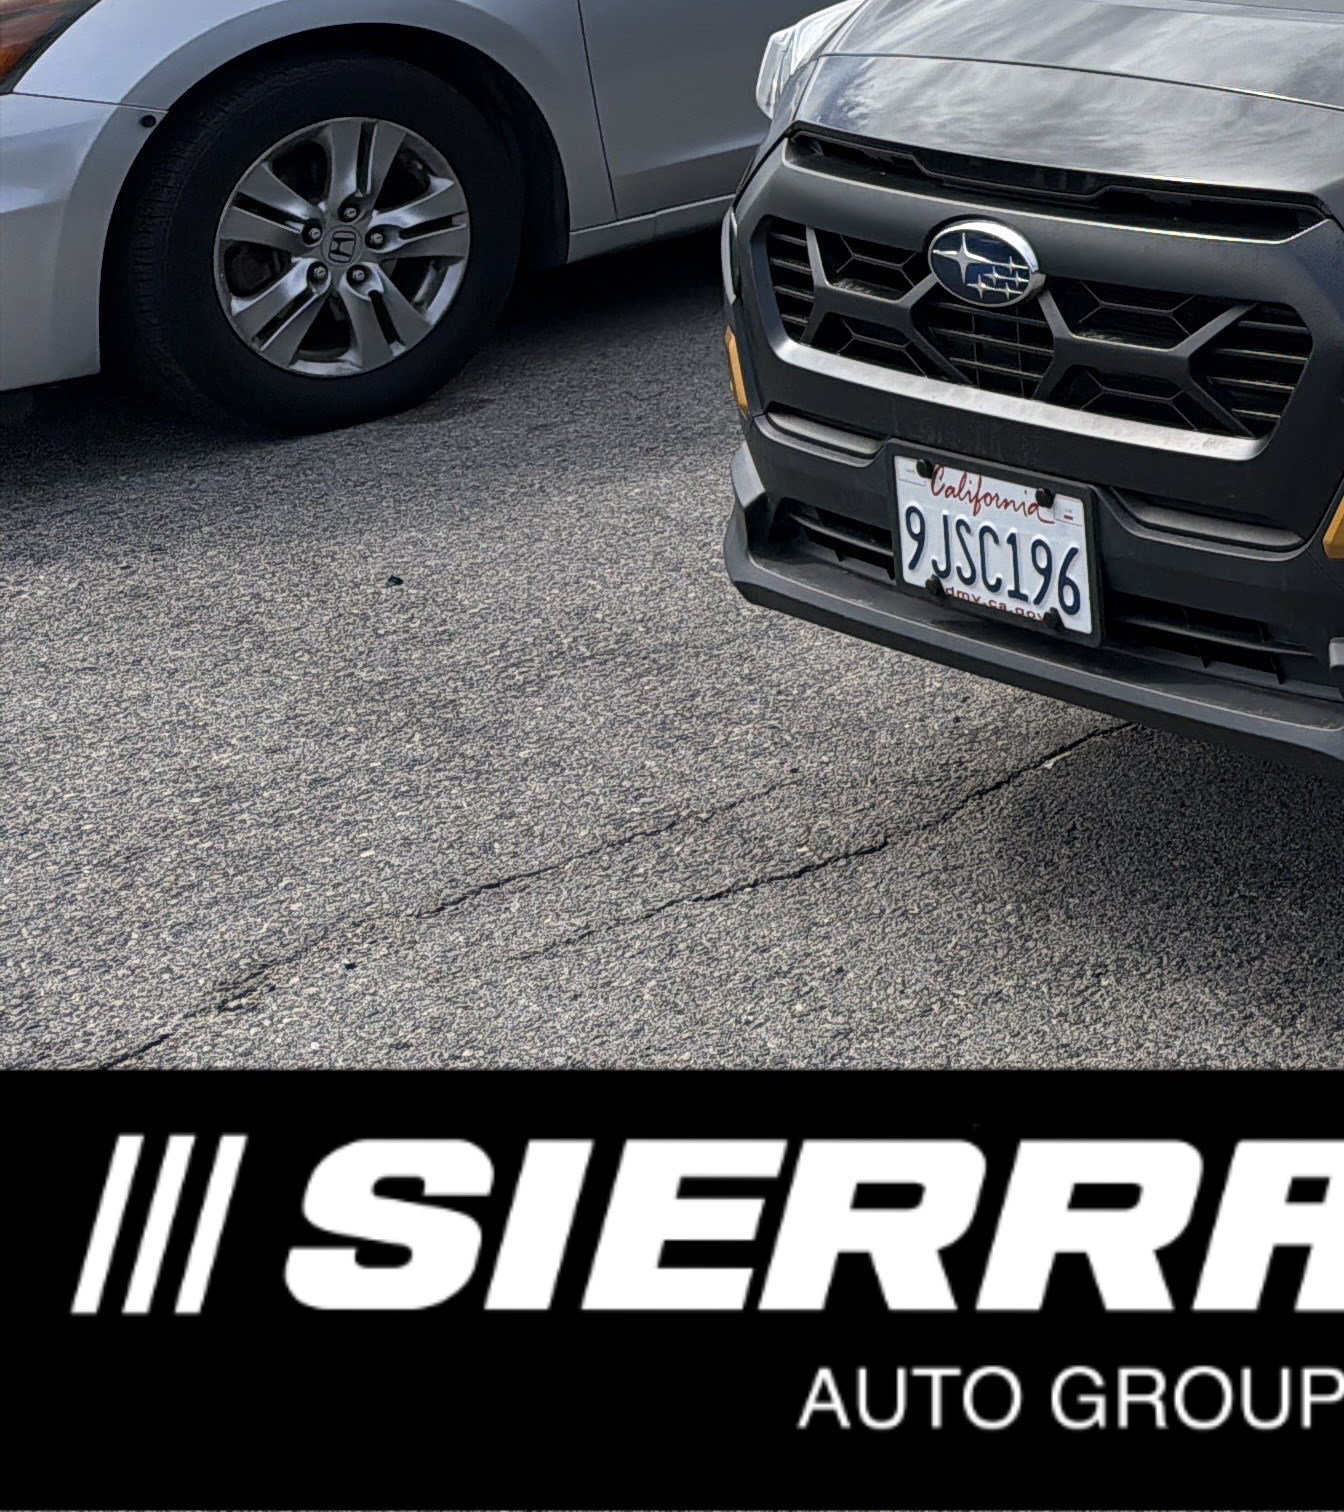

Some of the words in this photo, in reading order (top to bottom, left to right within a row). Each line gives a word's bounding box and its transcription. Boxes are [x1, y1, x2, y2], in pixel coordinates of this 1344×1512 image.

[930, 464, 1055, 524] California
[904, 505, 1081, 616] 9JSC196
[945, 586, 1044, 623] dmv.ca.gov
